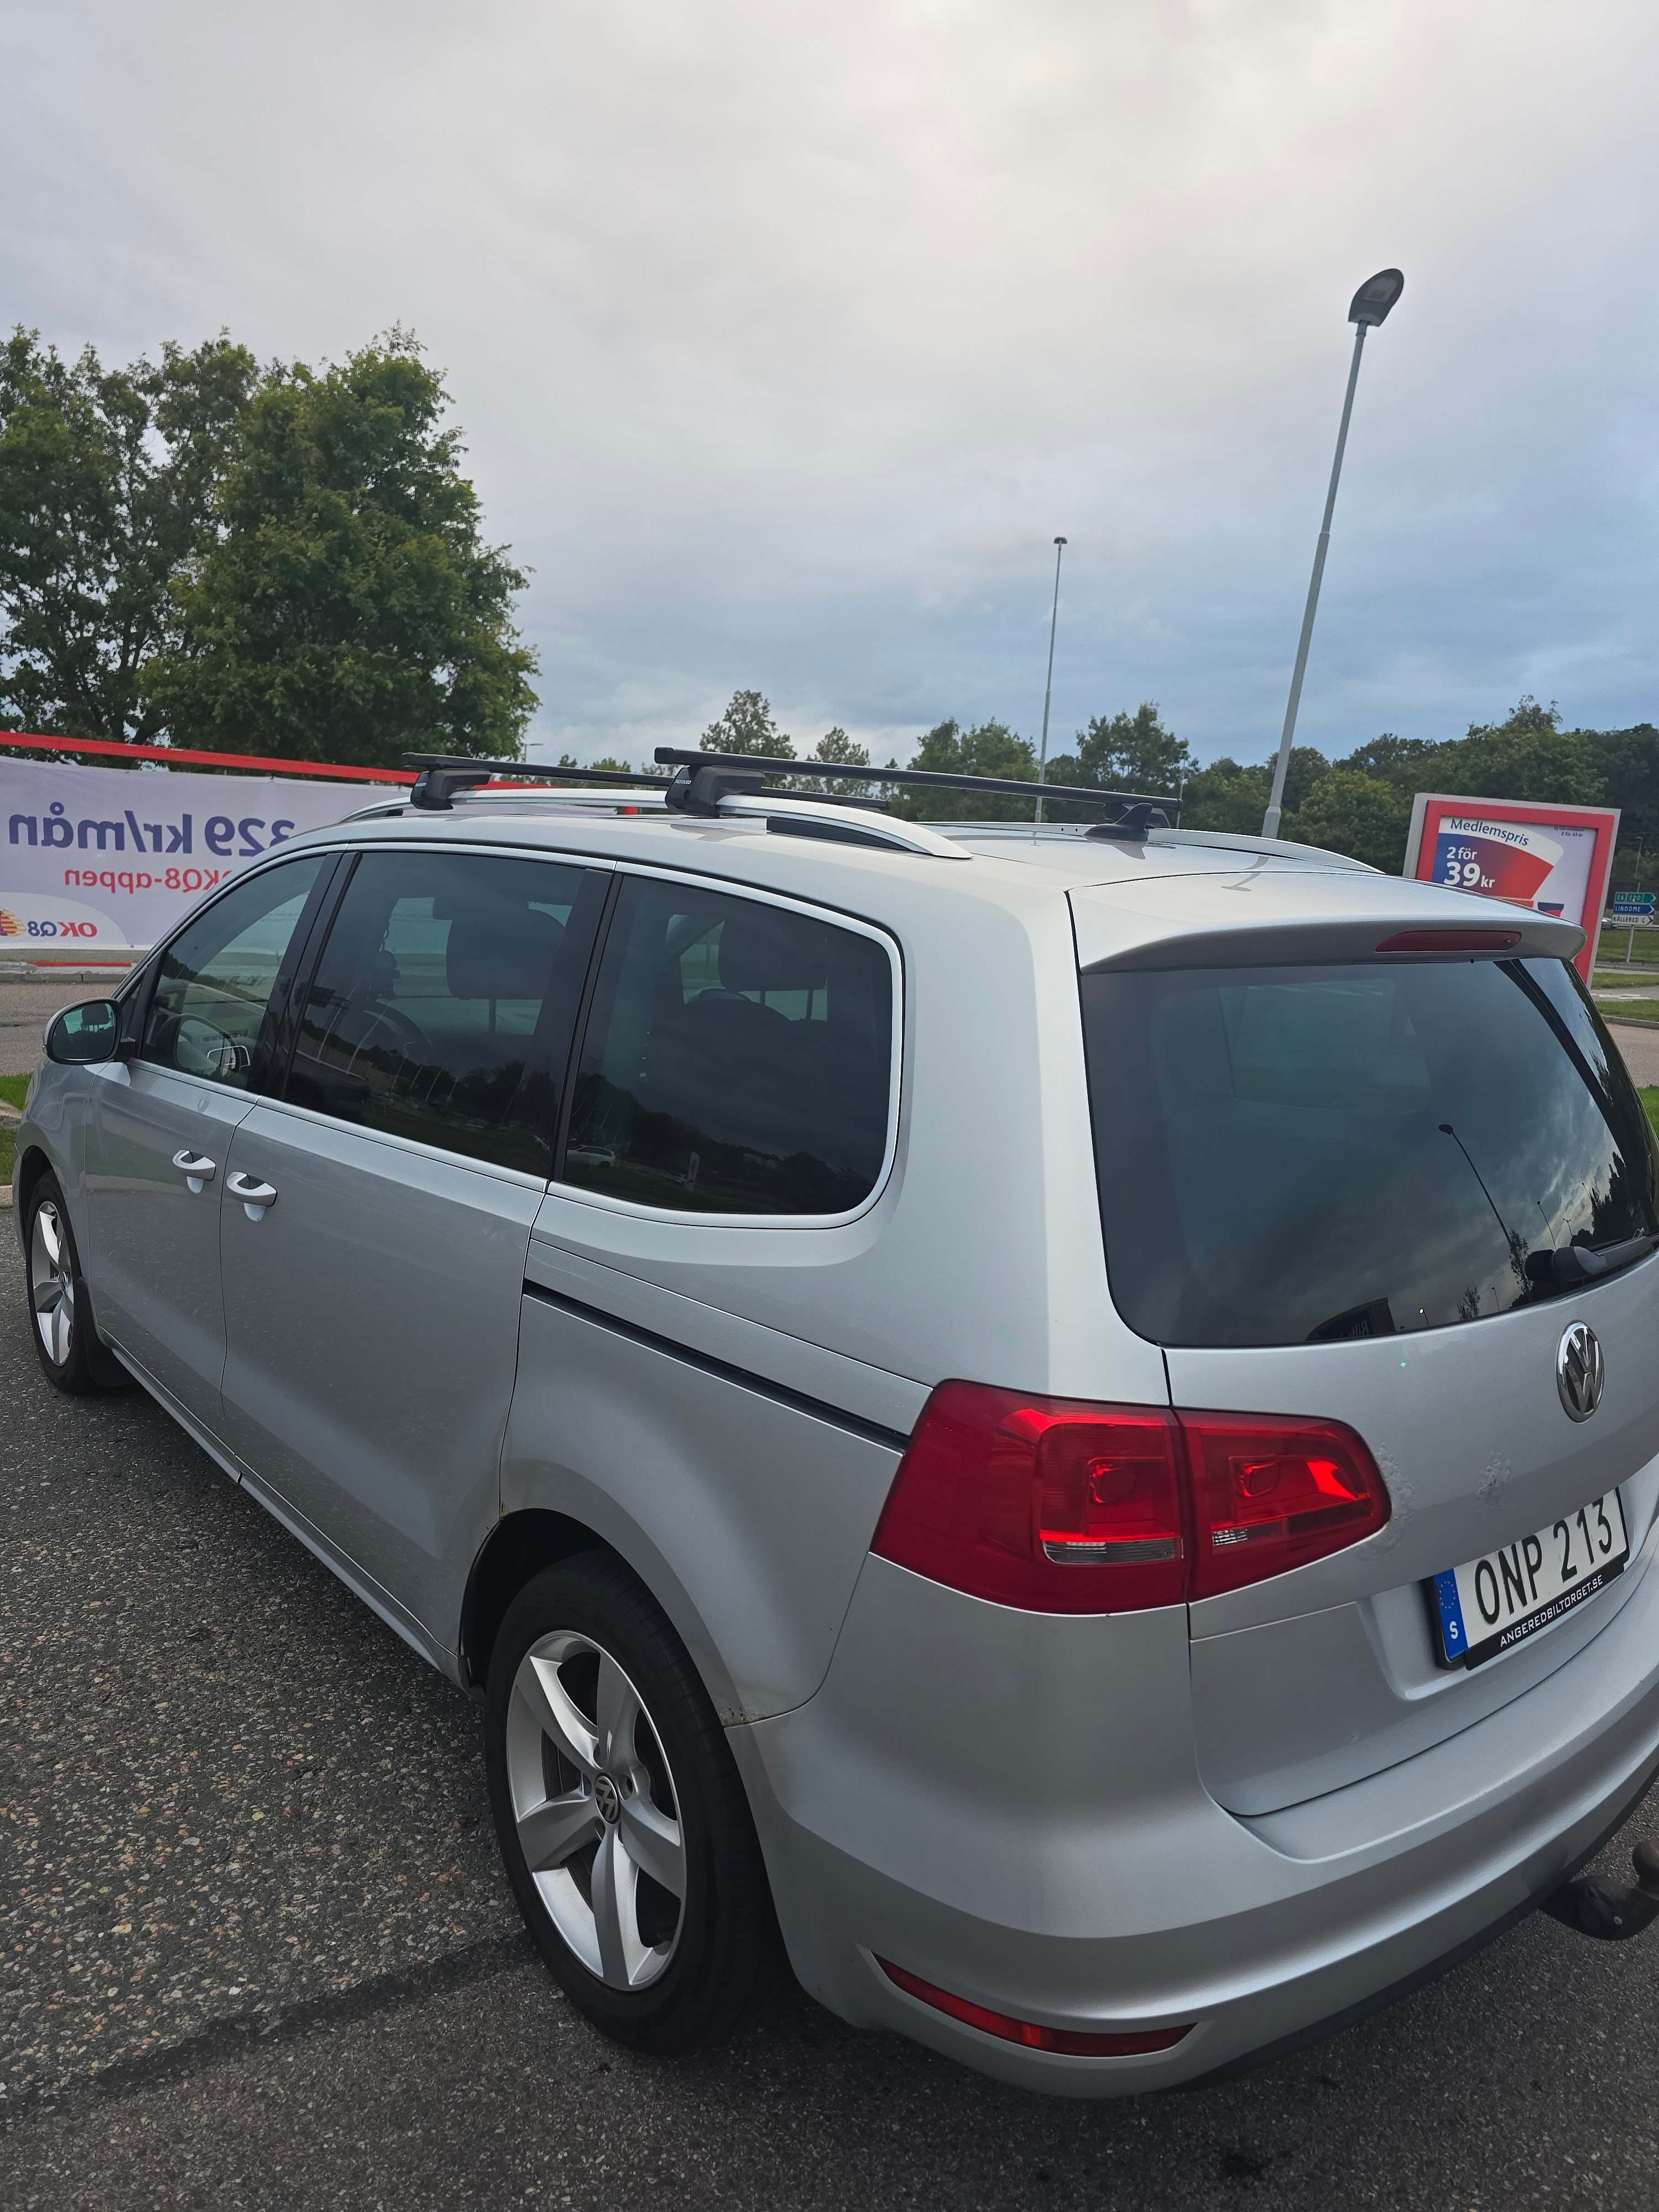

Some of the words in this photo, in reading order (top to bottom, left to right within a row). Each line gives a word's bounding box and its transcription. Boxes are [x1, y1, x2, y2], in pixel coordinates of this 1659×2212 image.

[1451, 818, 1530, 846] Medlemspris
[1447, 847, 1456, 859] 2
[1458, 847, 1478, 860] för
[1444, 862, 1480, 887] 39
[1480, 875, 1495, 888] kr
[1474, 1535, 1542, 1626] ONP
[1553, 1496, 1612, 1583] 213
[1500, 1574, 1604, 1648] ANGEREDBILTORGET.SE
[1449, 1621, 1458, 1640] S
